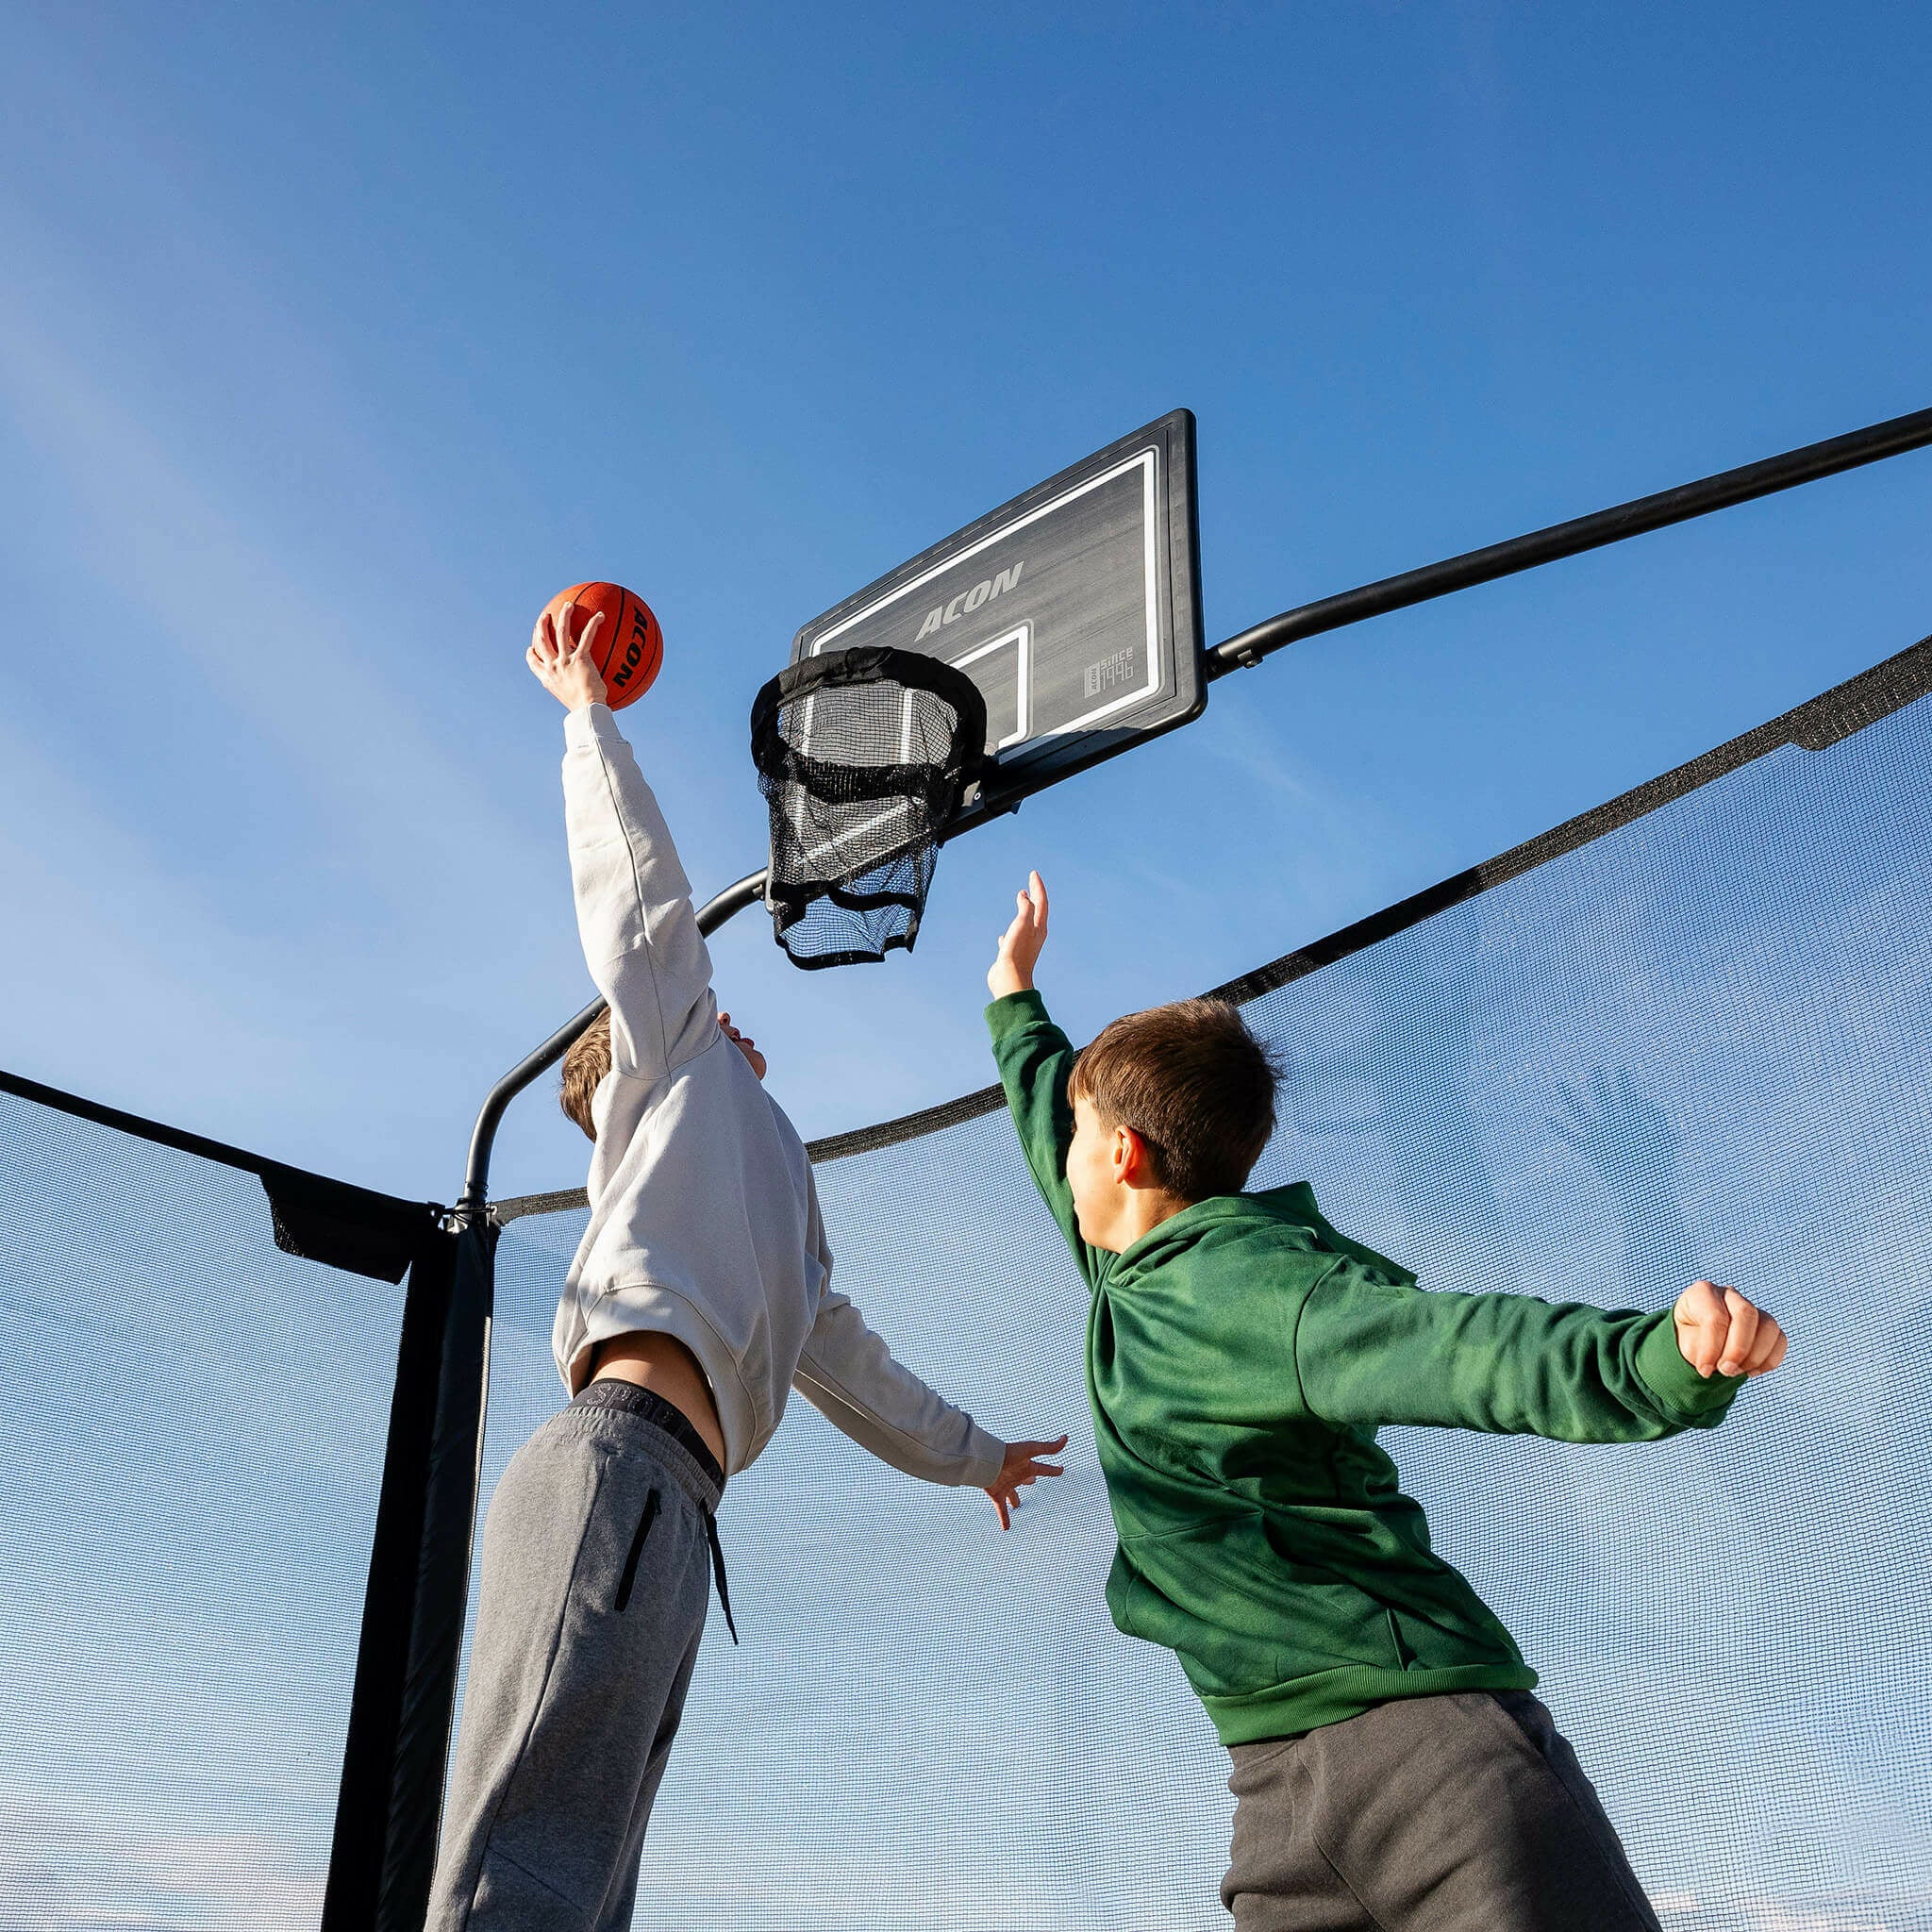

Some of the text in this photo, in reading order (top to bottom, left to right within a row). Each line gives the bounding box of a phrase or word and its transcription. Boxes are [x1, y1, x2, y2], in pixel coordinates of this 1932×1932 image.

[913, 559, 1025, 642] ACON
[613, 606, 649, 688] ACON
[1101, 646, 1133, 671] since
[1101, 661, 1134, 691] 1996
